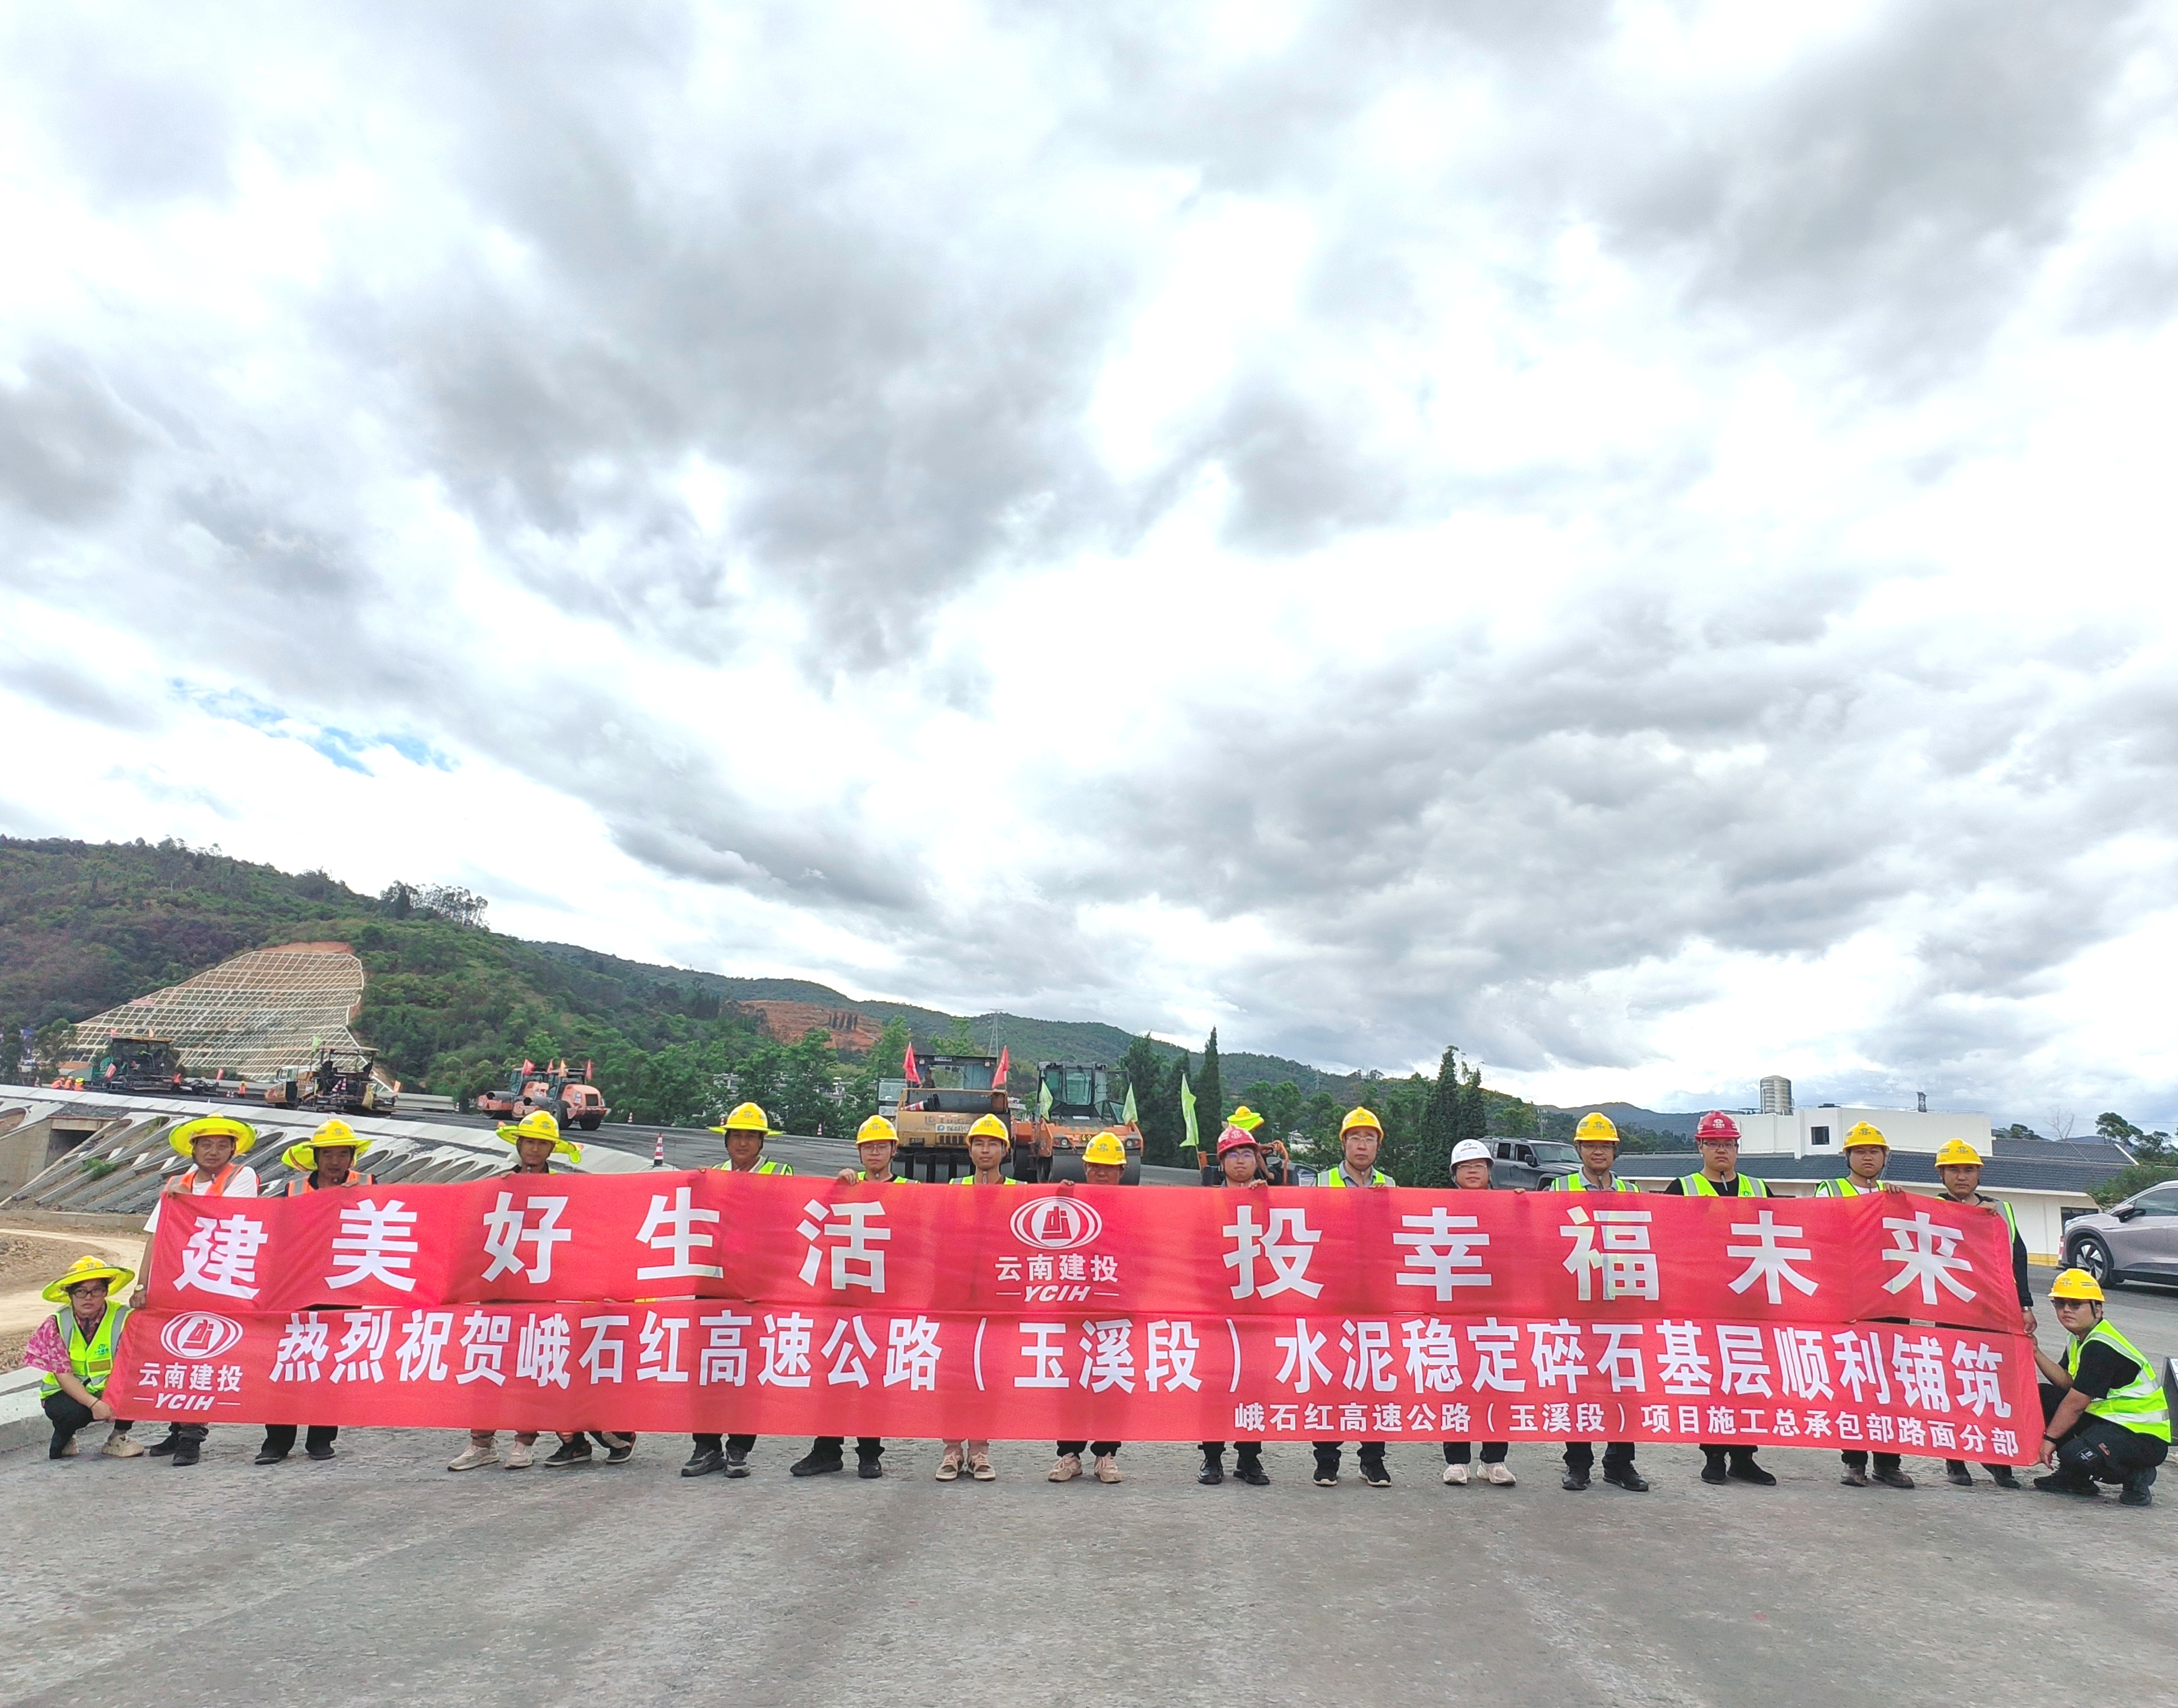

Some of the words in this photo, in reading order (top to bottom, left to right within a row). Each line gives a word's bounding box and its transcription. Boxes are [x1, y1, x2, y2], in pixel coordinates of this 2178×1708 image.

[173, 1186, 892, 1300] 建美好生活
[1222, 1205, 1977, 1306] 投幸福未来
[995, 1253, 1118, 1283] 云南建投
[1024, 1285, 1091, 1302] YCIH
[138, 1362, 243, 1392] 云南建投
[154, 1393, 216, 1410] YCIH
